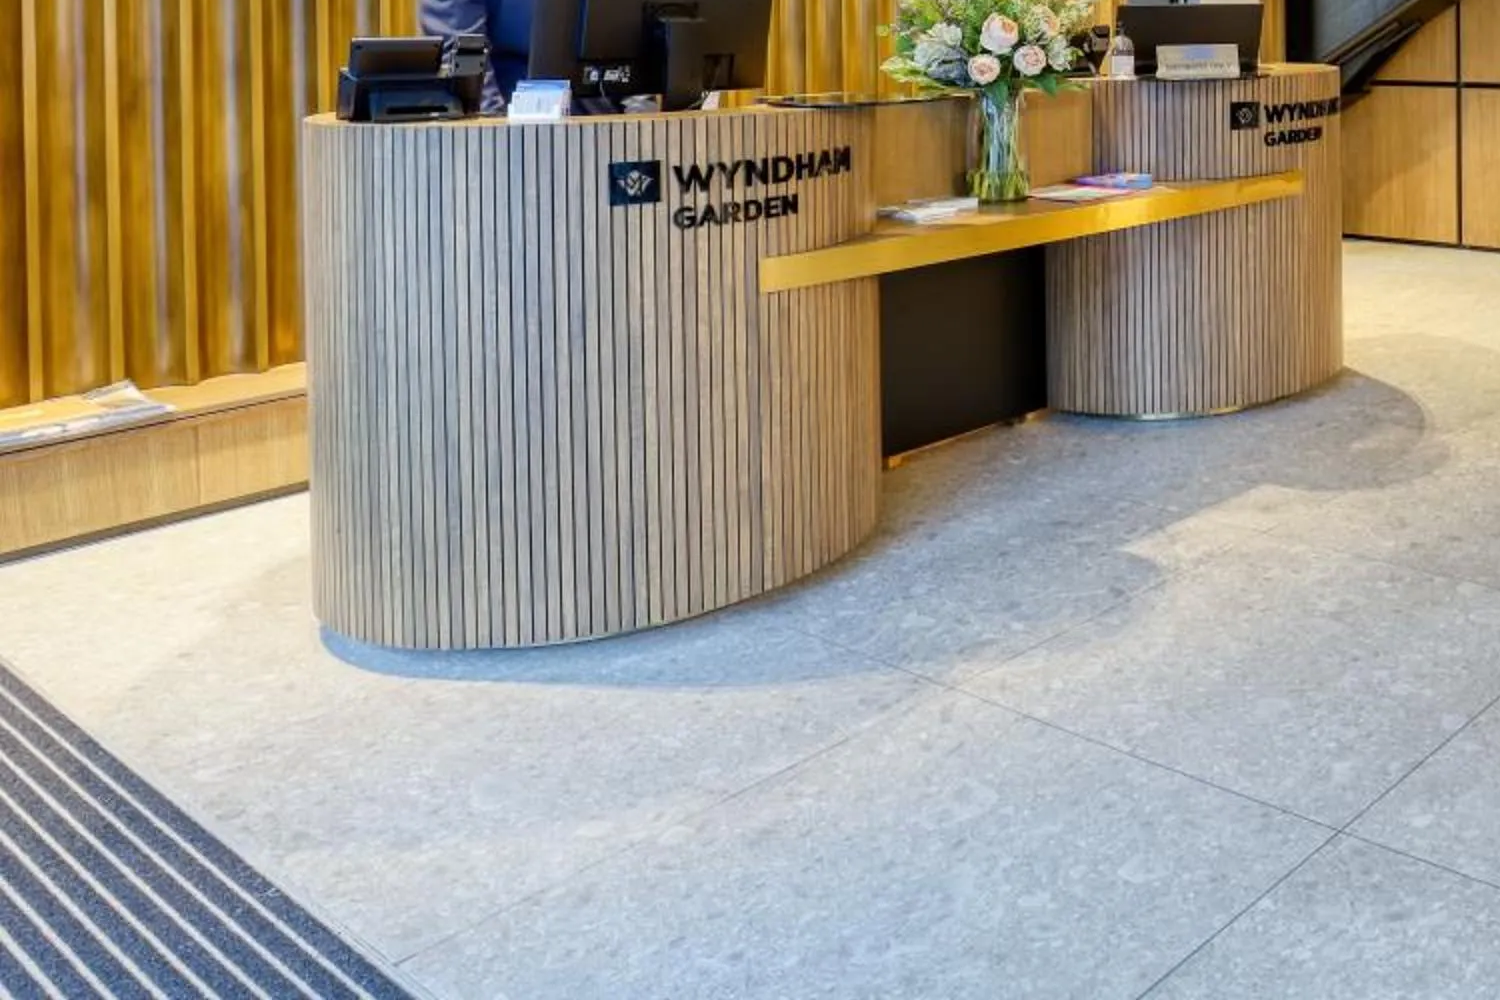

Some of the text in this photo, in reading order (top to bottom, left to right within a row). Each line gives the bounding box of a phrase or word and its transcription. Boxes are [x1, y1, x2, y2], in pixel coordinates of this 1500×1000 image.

[1264, 97, 1339, 122] WYNDH
[672, 146, 851, 193] WYNDHAM
[672, 193, 799, 230] GARDEN
